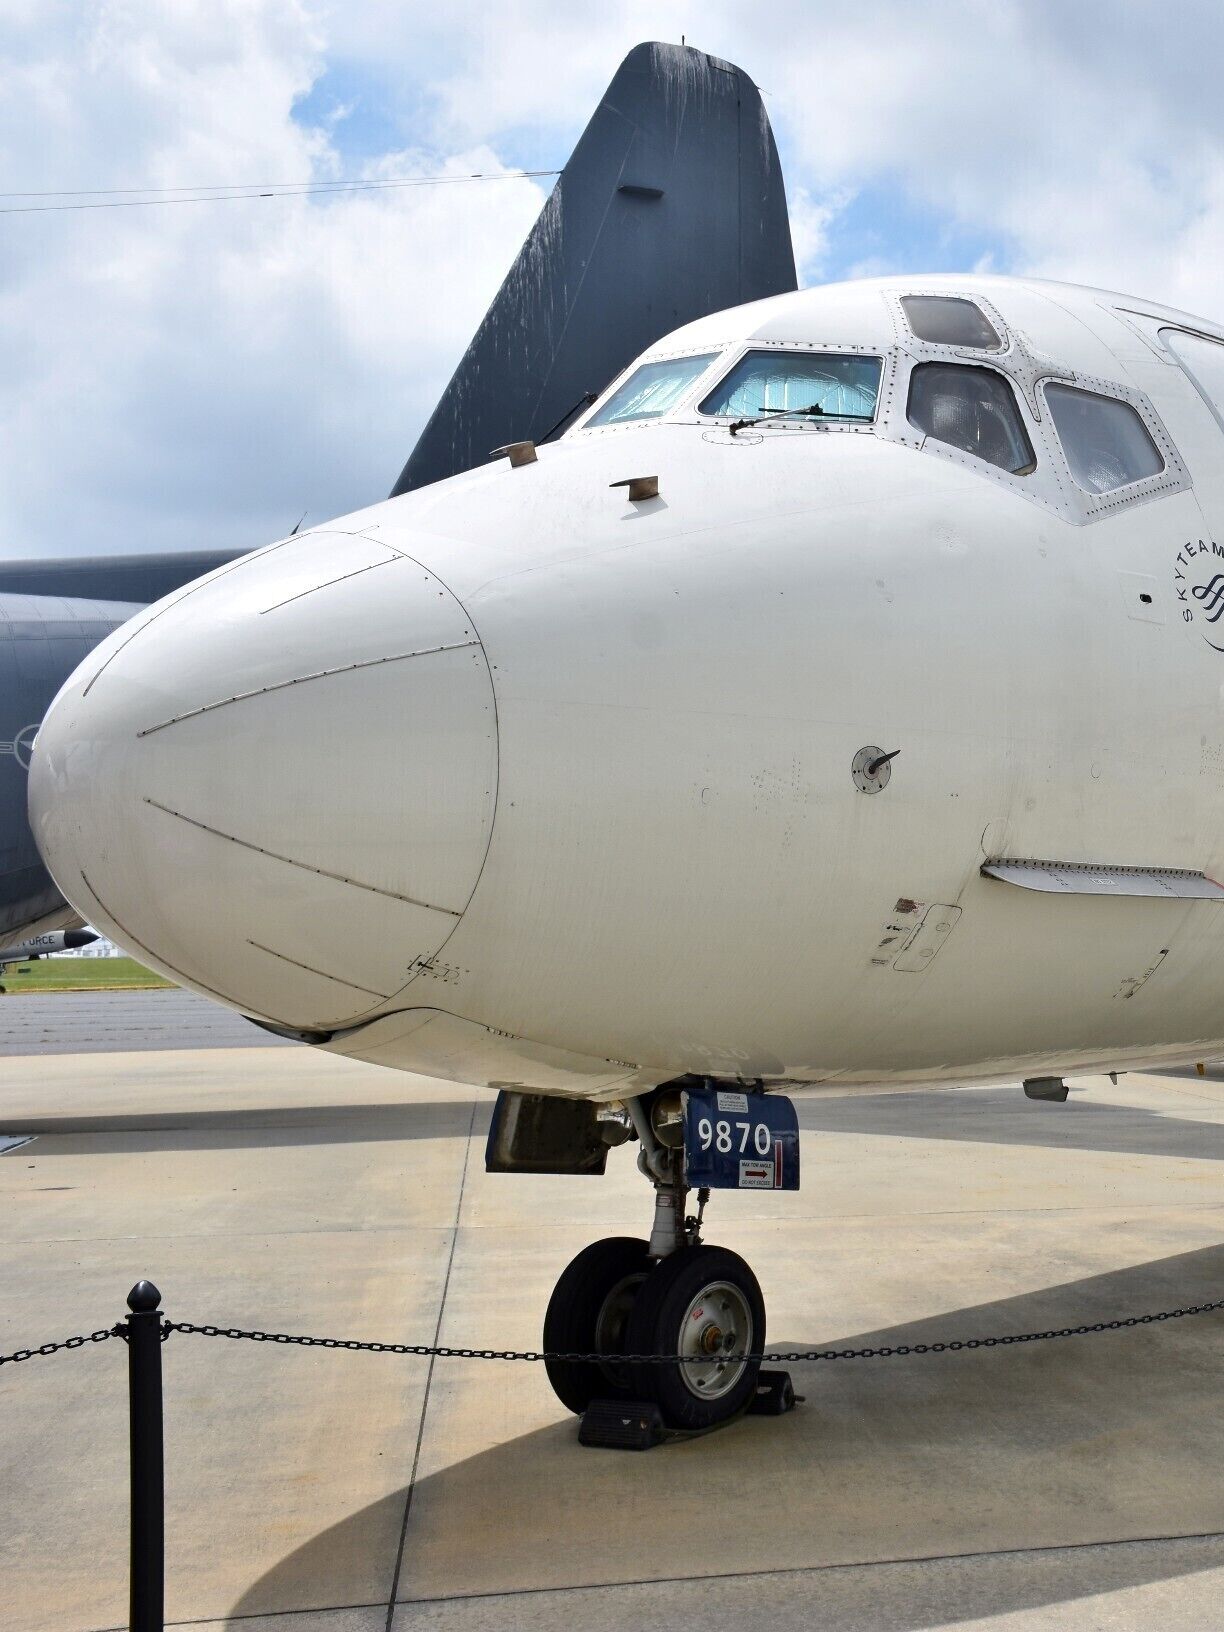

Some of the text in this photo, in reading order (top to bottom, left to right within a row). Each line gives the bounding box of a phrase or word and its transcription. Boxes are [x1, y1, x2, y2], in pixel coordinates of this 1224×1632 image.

[1174, 539, 1224, 622] SKYTEAM
[22, 935, 55, 946] ORCE
[698, 1118, 771, 1155] 9870
